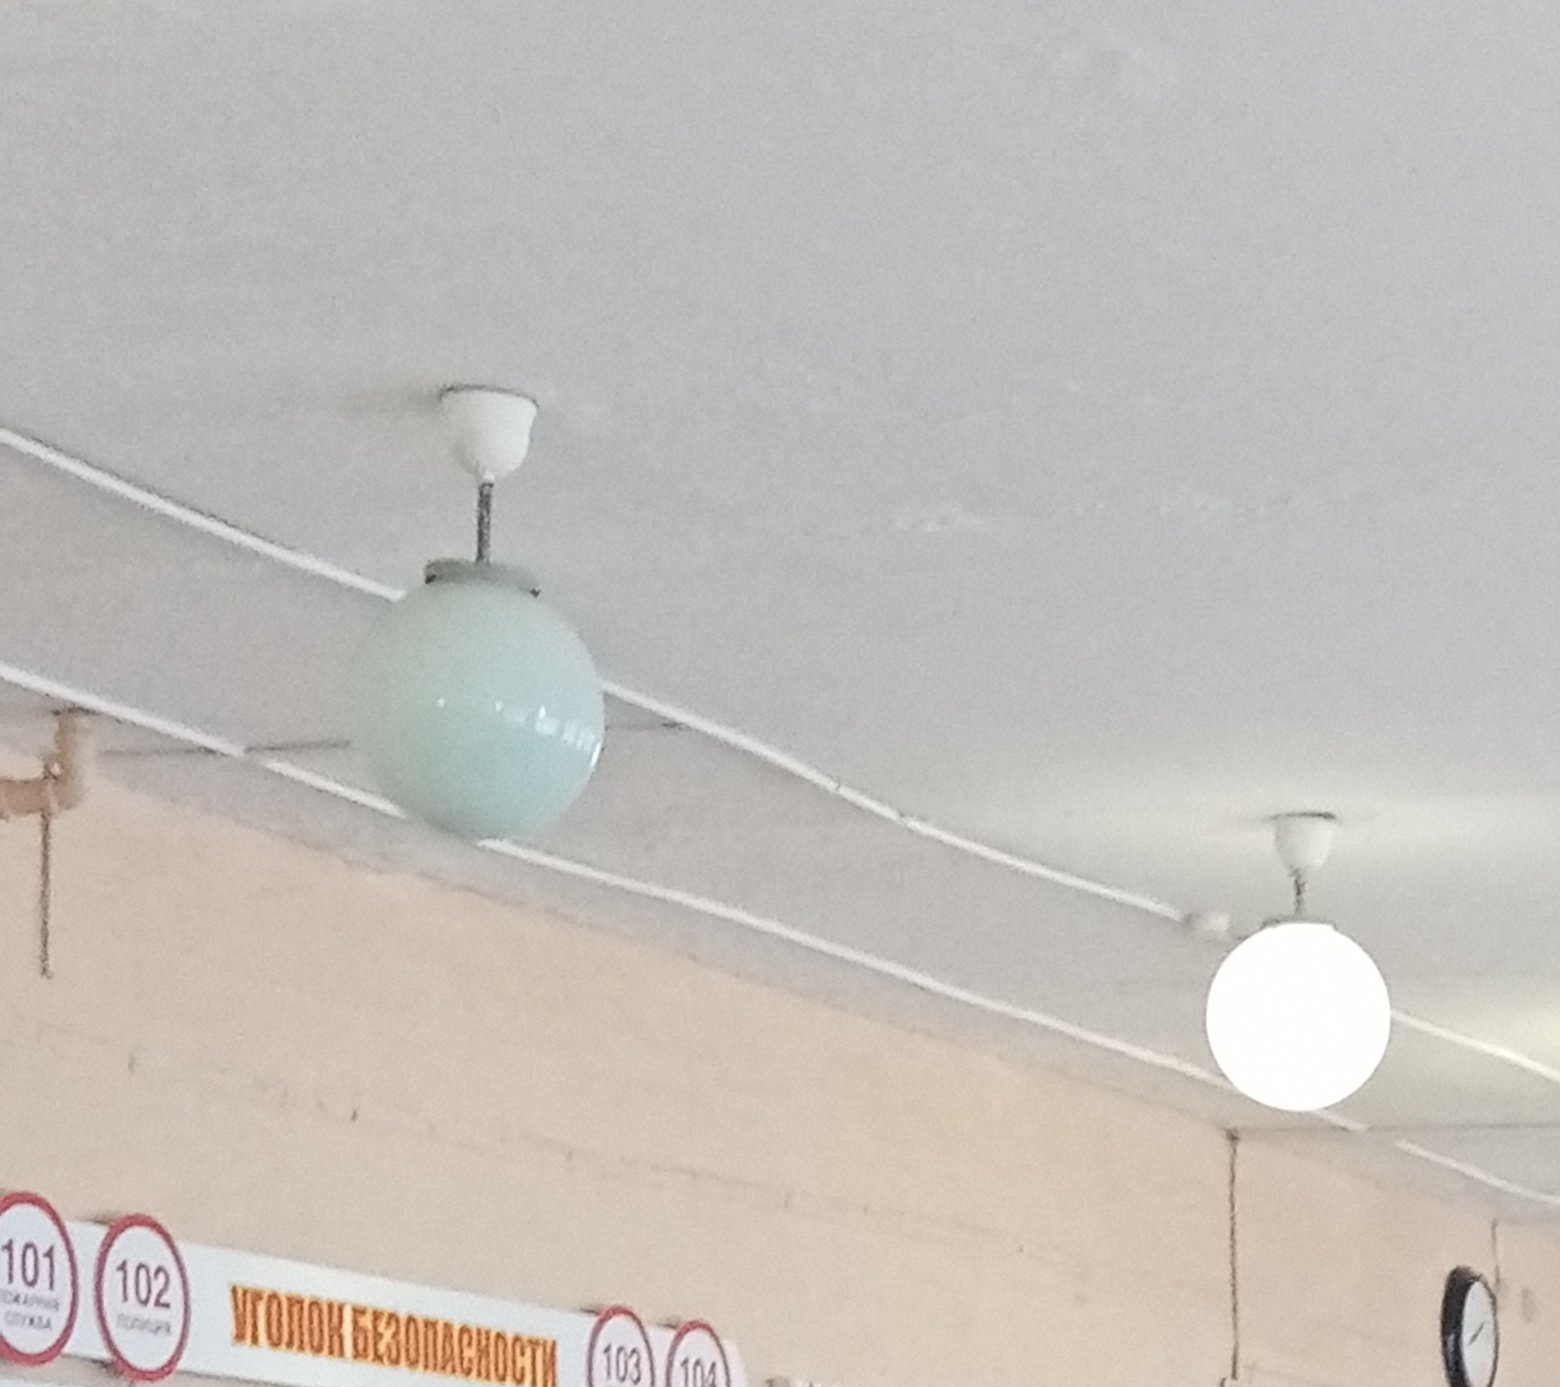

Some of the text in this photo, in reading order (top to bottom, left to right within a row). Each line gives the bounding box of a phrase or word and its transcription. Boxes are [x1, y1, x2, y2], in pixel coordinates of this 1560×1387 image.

[2, 1238, 55, 1291] 101
[116, 1259, 171, 1309] 102
[231, 1285, 345, 1358] УГОЛОК
[603, 1343, 642, 1386] 103
